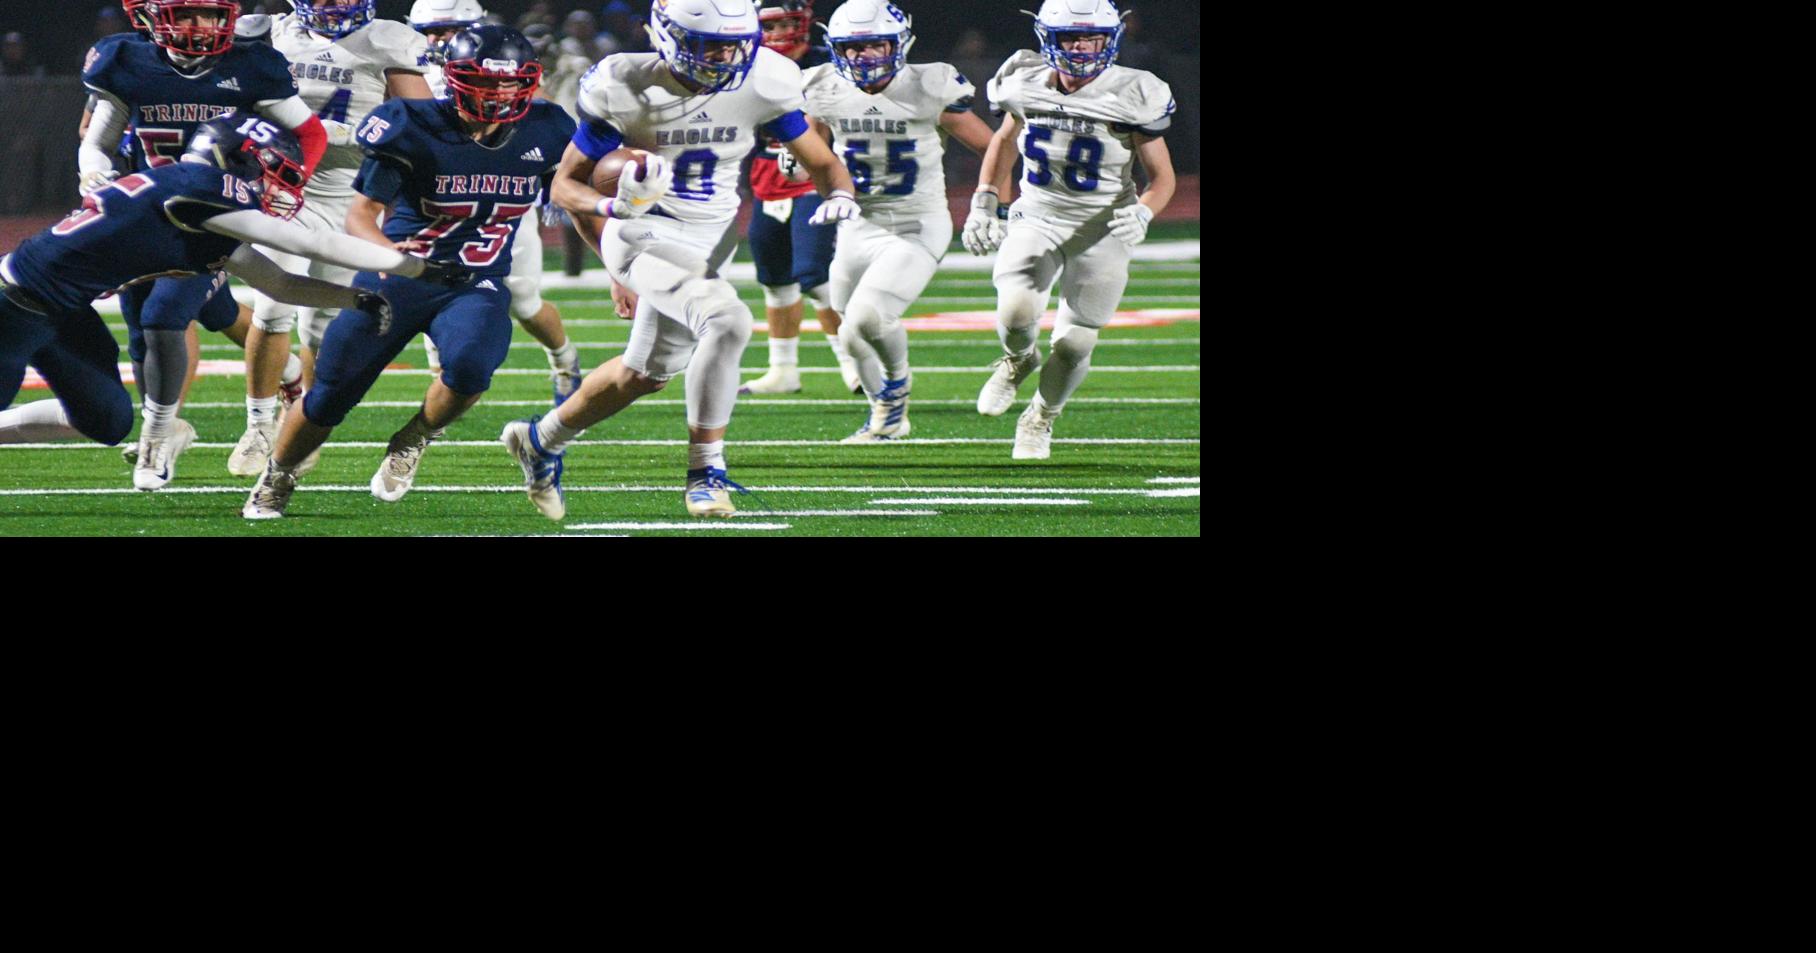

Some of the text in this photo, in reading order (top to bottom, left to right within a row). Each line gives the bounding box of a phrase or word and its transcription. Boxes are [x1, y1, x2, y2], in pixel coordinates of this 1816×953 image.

[293, 62, 355, 85] AGLES
[235, 117, 280, 143] 15
[358, 115, 391, 143] 75
[656, 126, 738, 146] EAGLES
[838, 118, 908, 135] EAGLES
[1024, 123, 1105, 192] 58
[222, 173, 251, 204] 15
[435, 174, 537, 196] TRINITY
[408, 197, 534, 267] 75
